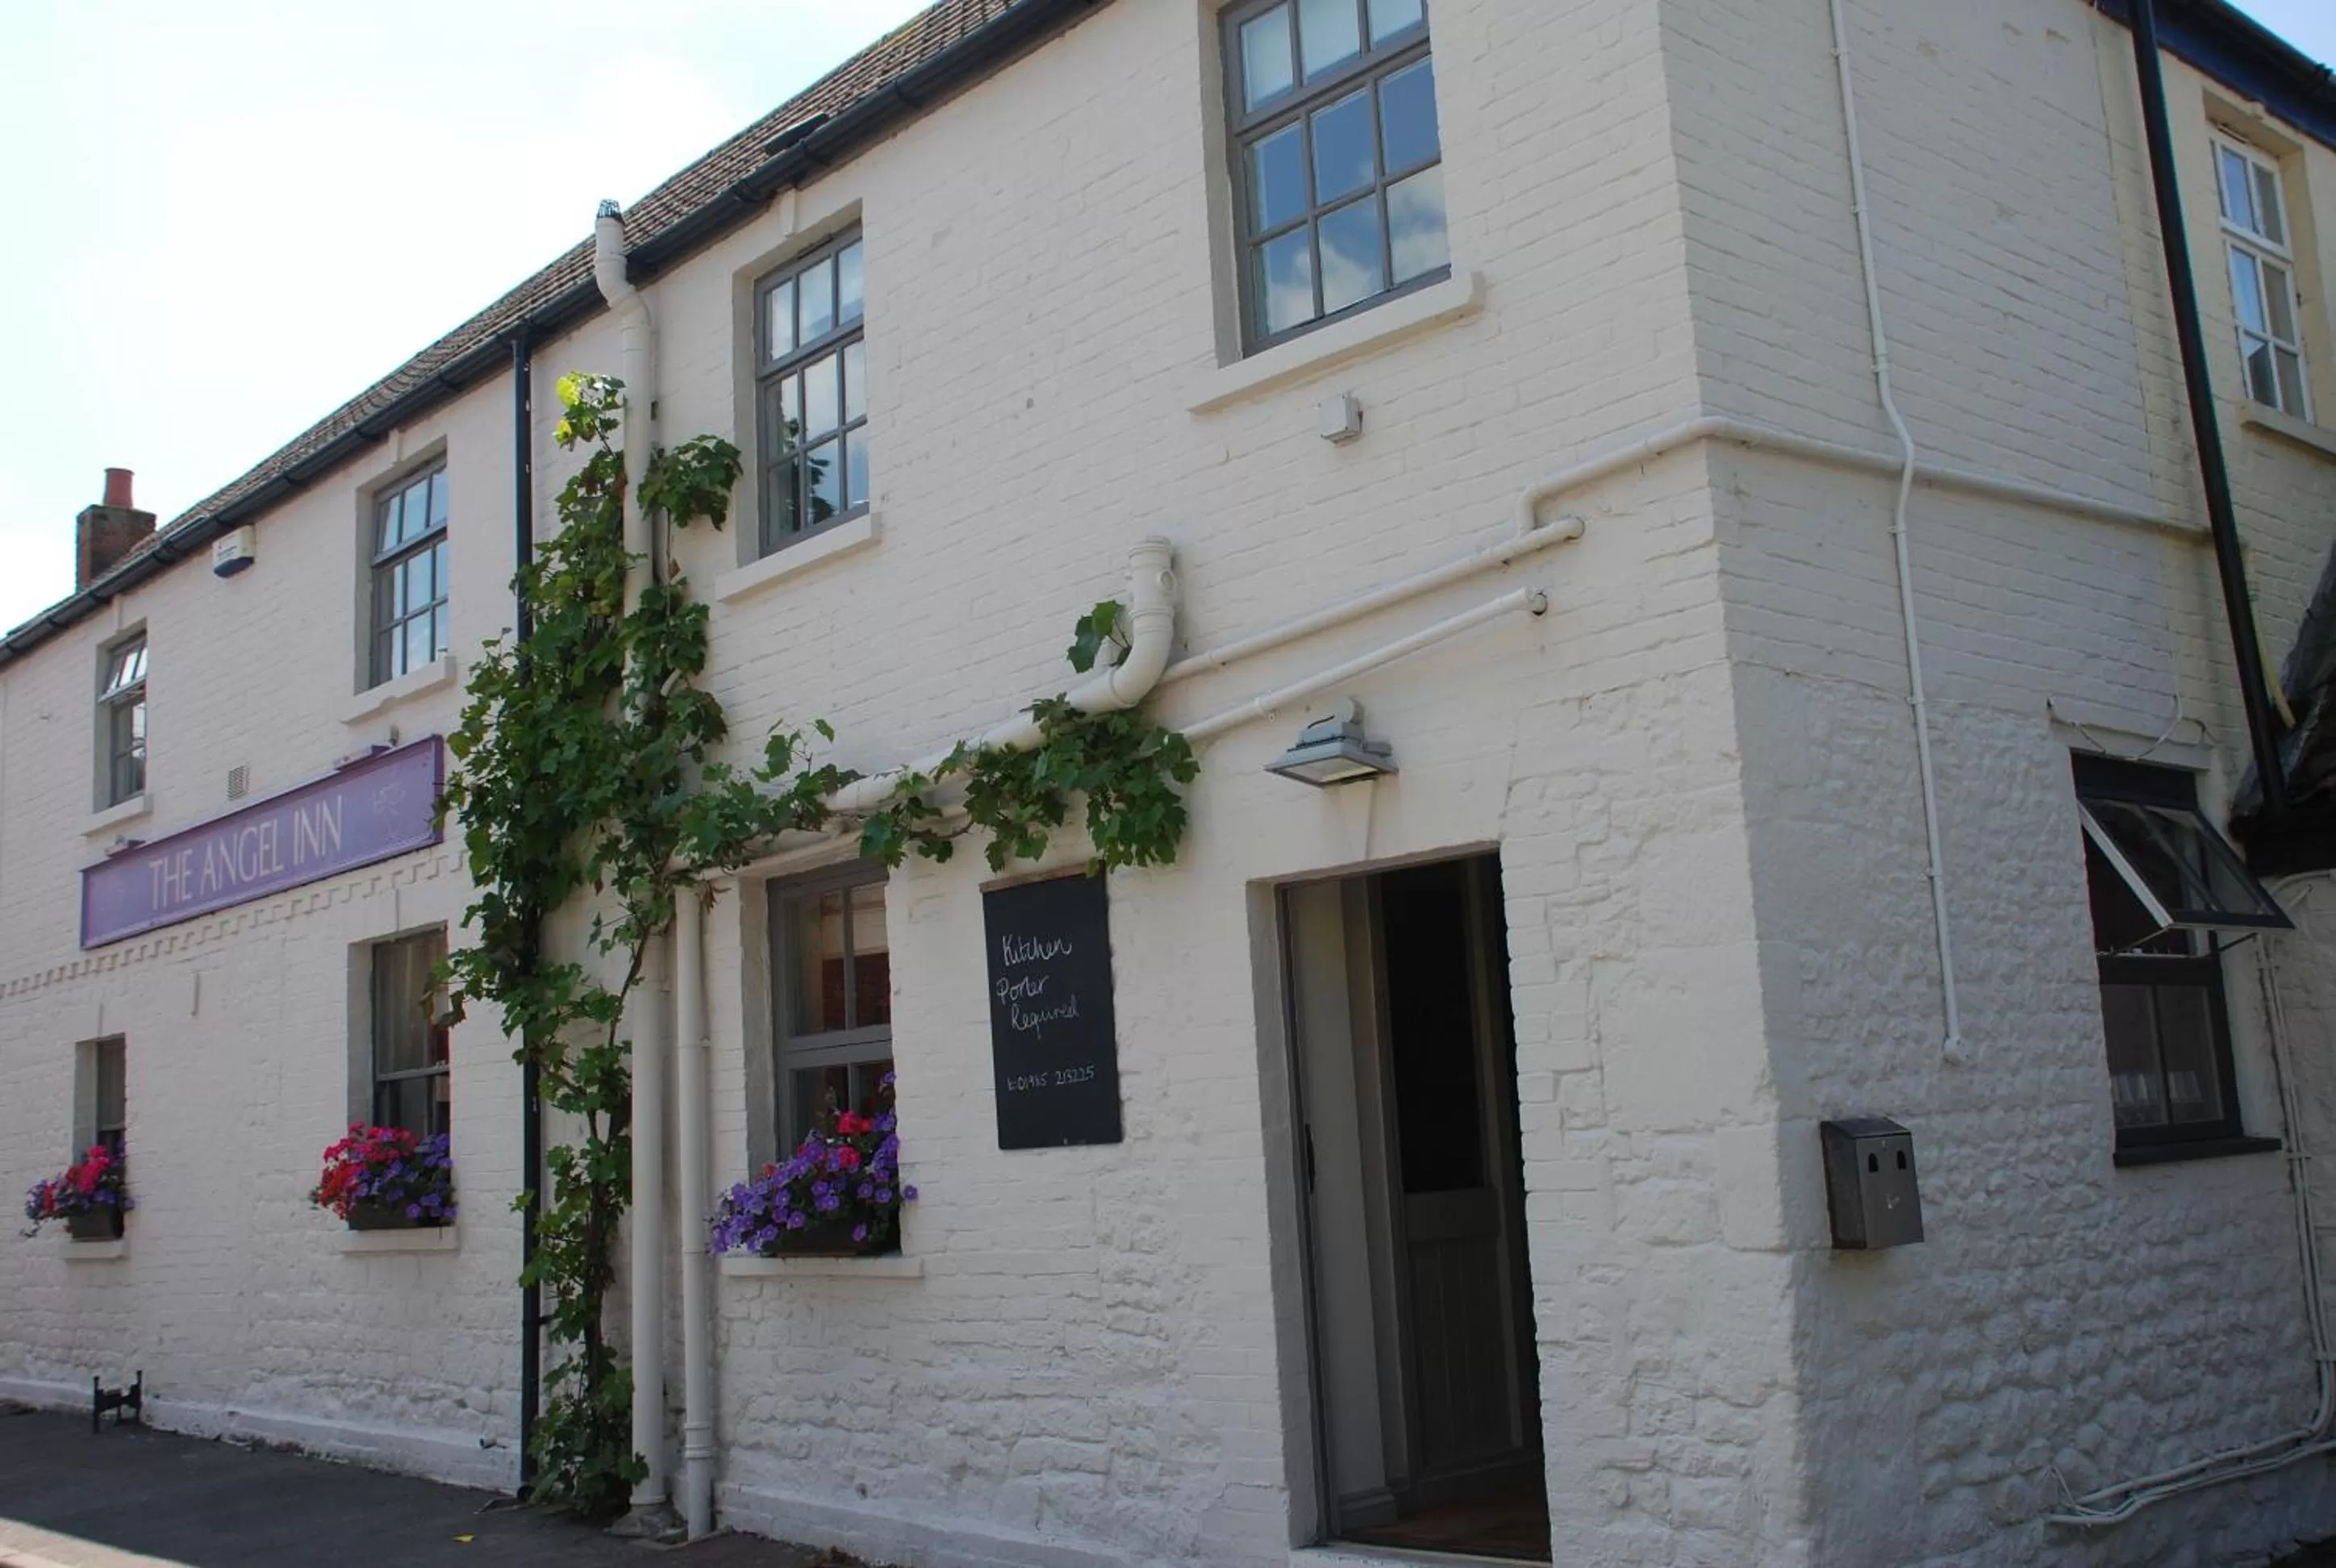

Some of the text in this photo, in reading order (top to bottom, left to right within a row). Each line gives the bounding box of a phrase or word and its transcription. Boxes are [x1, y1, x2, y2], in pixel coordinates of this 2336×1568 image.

[148, 794, 343, 910] THE ANGEL INN
[1002, 933, 1073, 967] Kitchen
[995, 975, 1050, 1005] Porter
[1011, 994, 1079, 1040] Required
